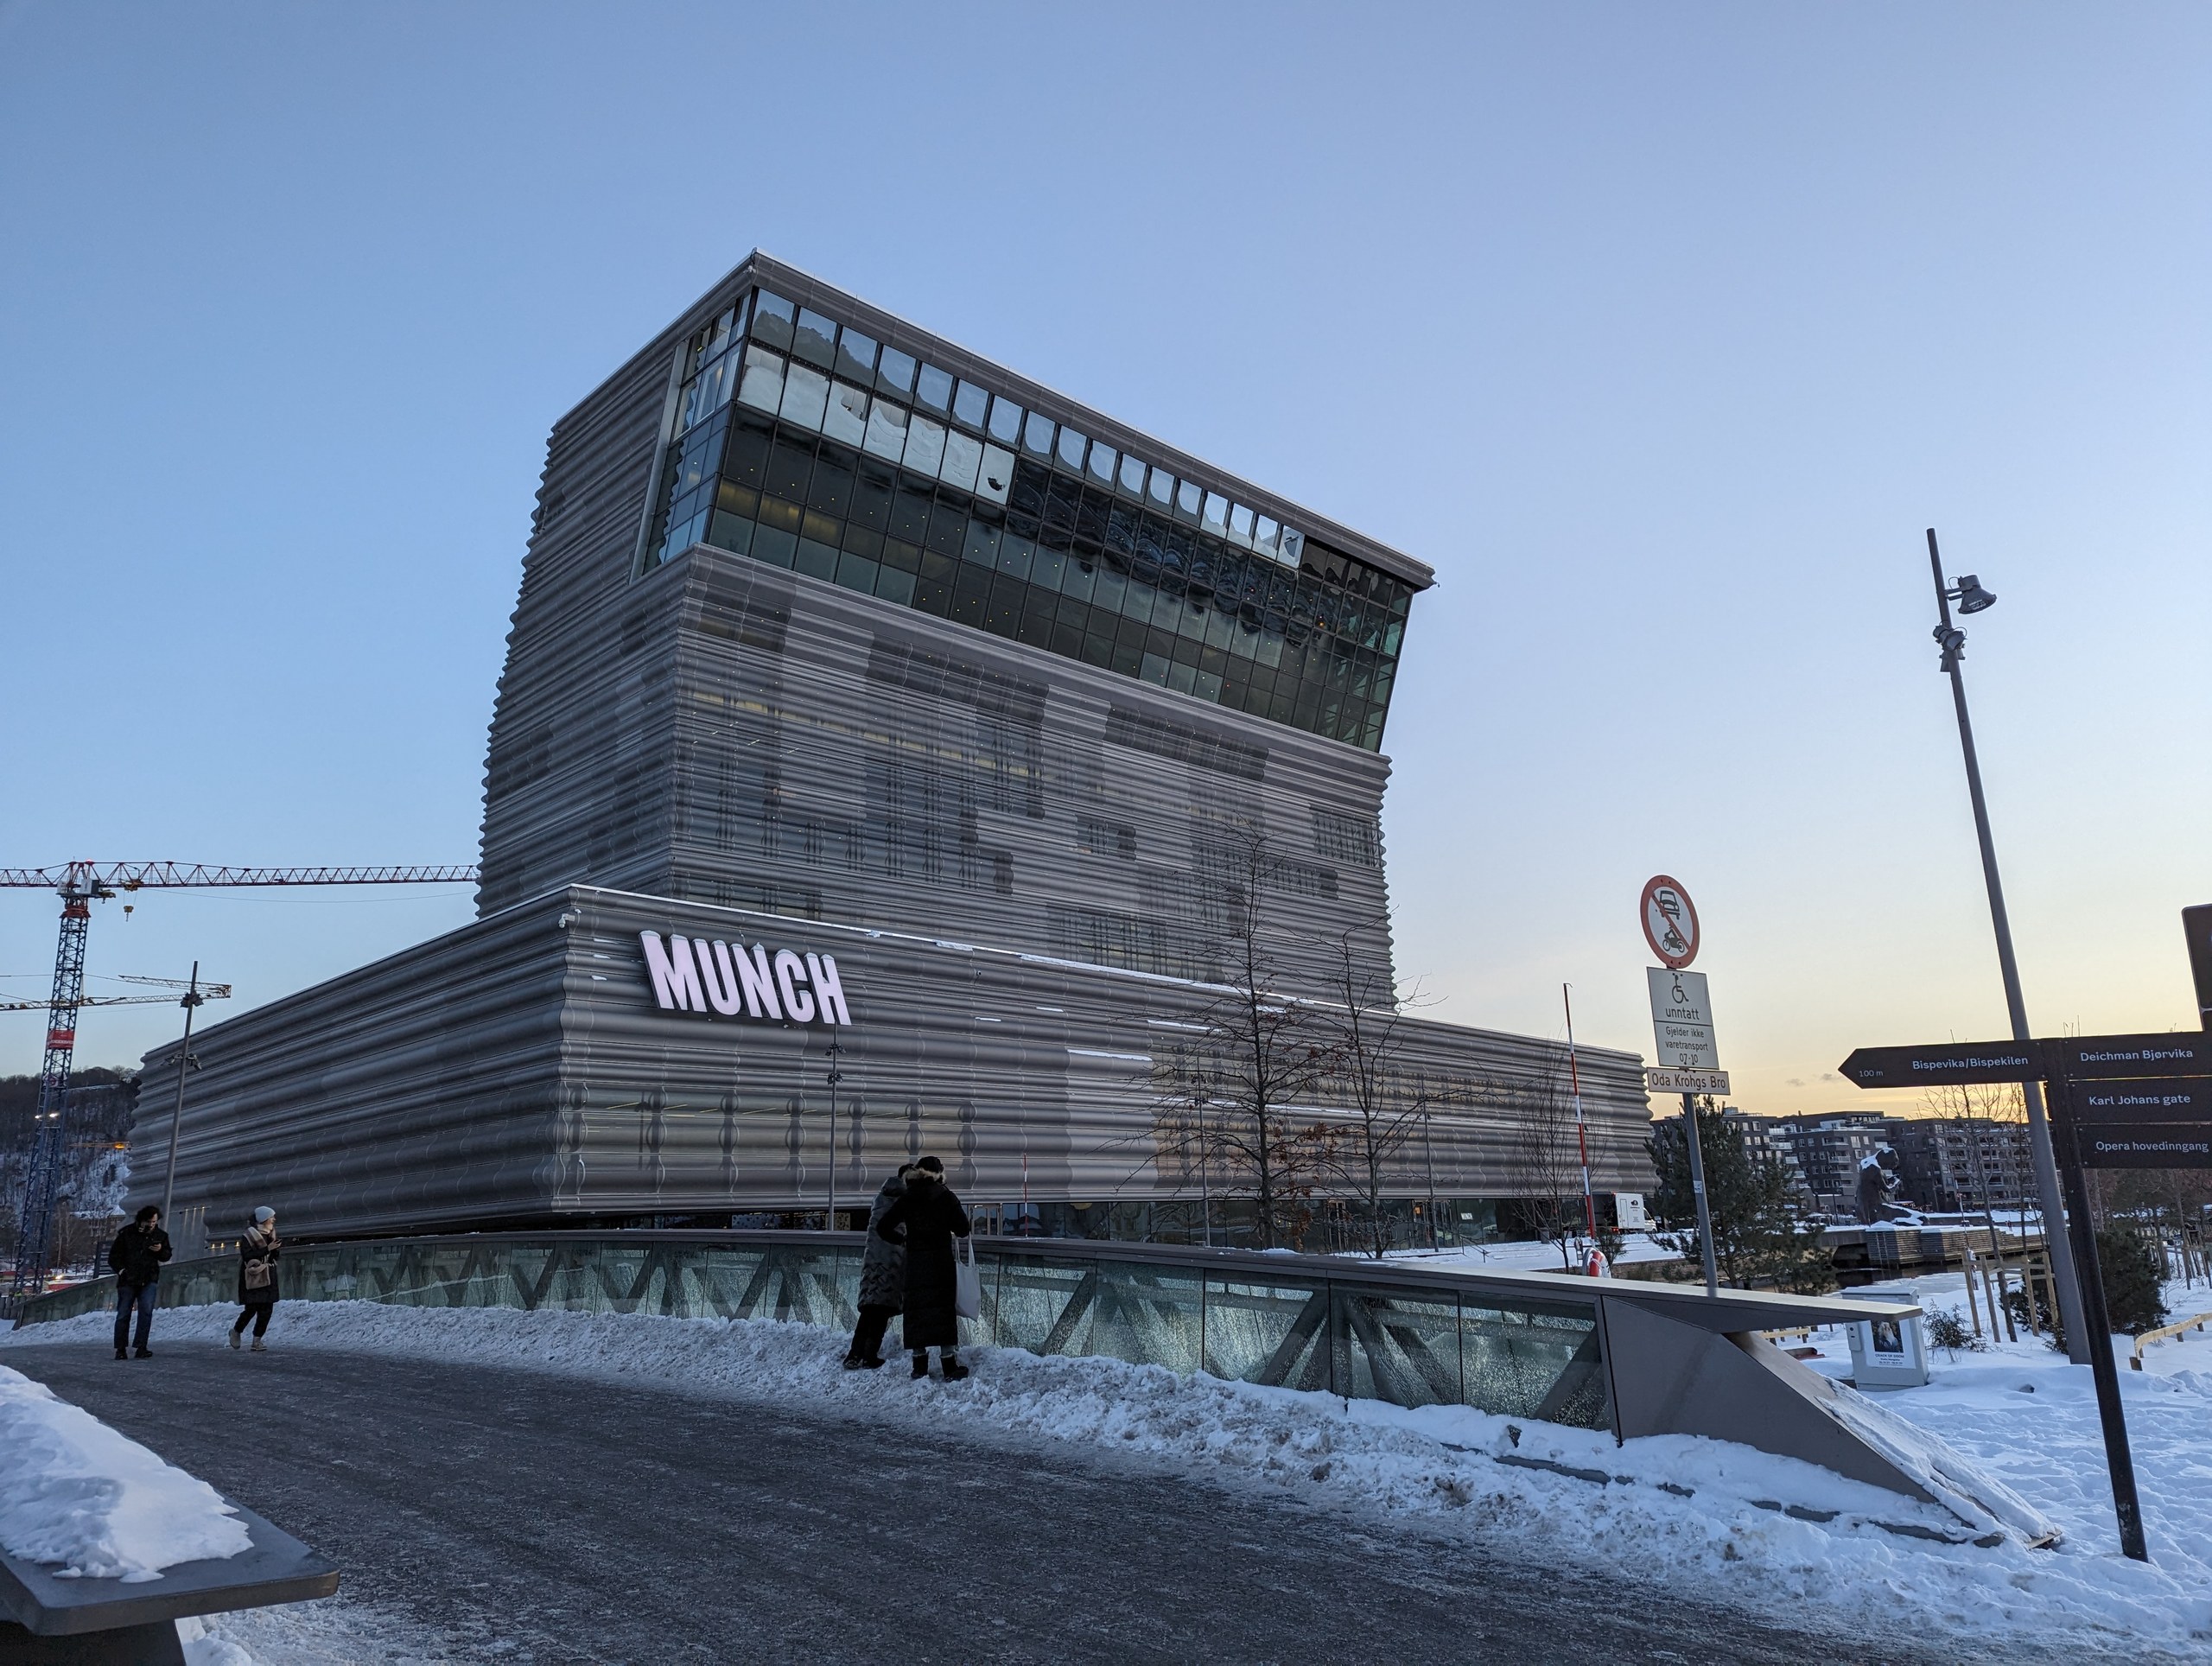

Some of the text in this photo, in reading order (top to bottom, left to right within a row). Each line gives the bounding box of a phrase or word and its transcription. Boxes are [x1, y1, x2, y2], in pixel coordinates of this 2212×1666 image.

[639, 931, 852, 1026] MUNCH
[1665, 1007, 1700, 1021] unntatt
[1665, 1026, 1705, 1038] Gjelder ikke
[1665, 1040, 1709, 1052] varetransport
[1679, 1052, 1699, 1065] 07-10
[2080, 1048, 2194, 1062] Deichman Bjørvika
[1912, 1056, 2029, 1071] Bispevika/Bispekilen
[1651, 1072, 1726, 1091] Oda Krohgs Bro
[2088, 1094, 2191, 1106] Karl Johans gate
[2095, 1141, 2209, 1153] Opera hovedinngang
